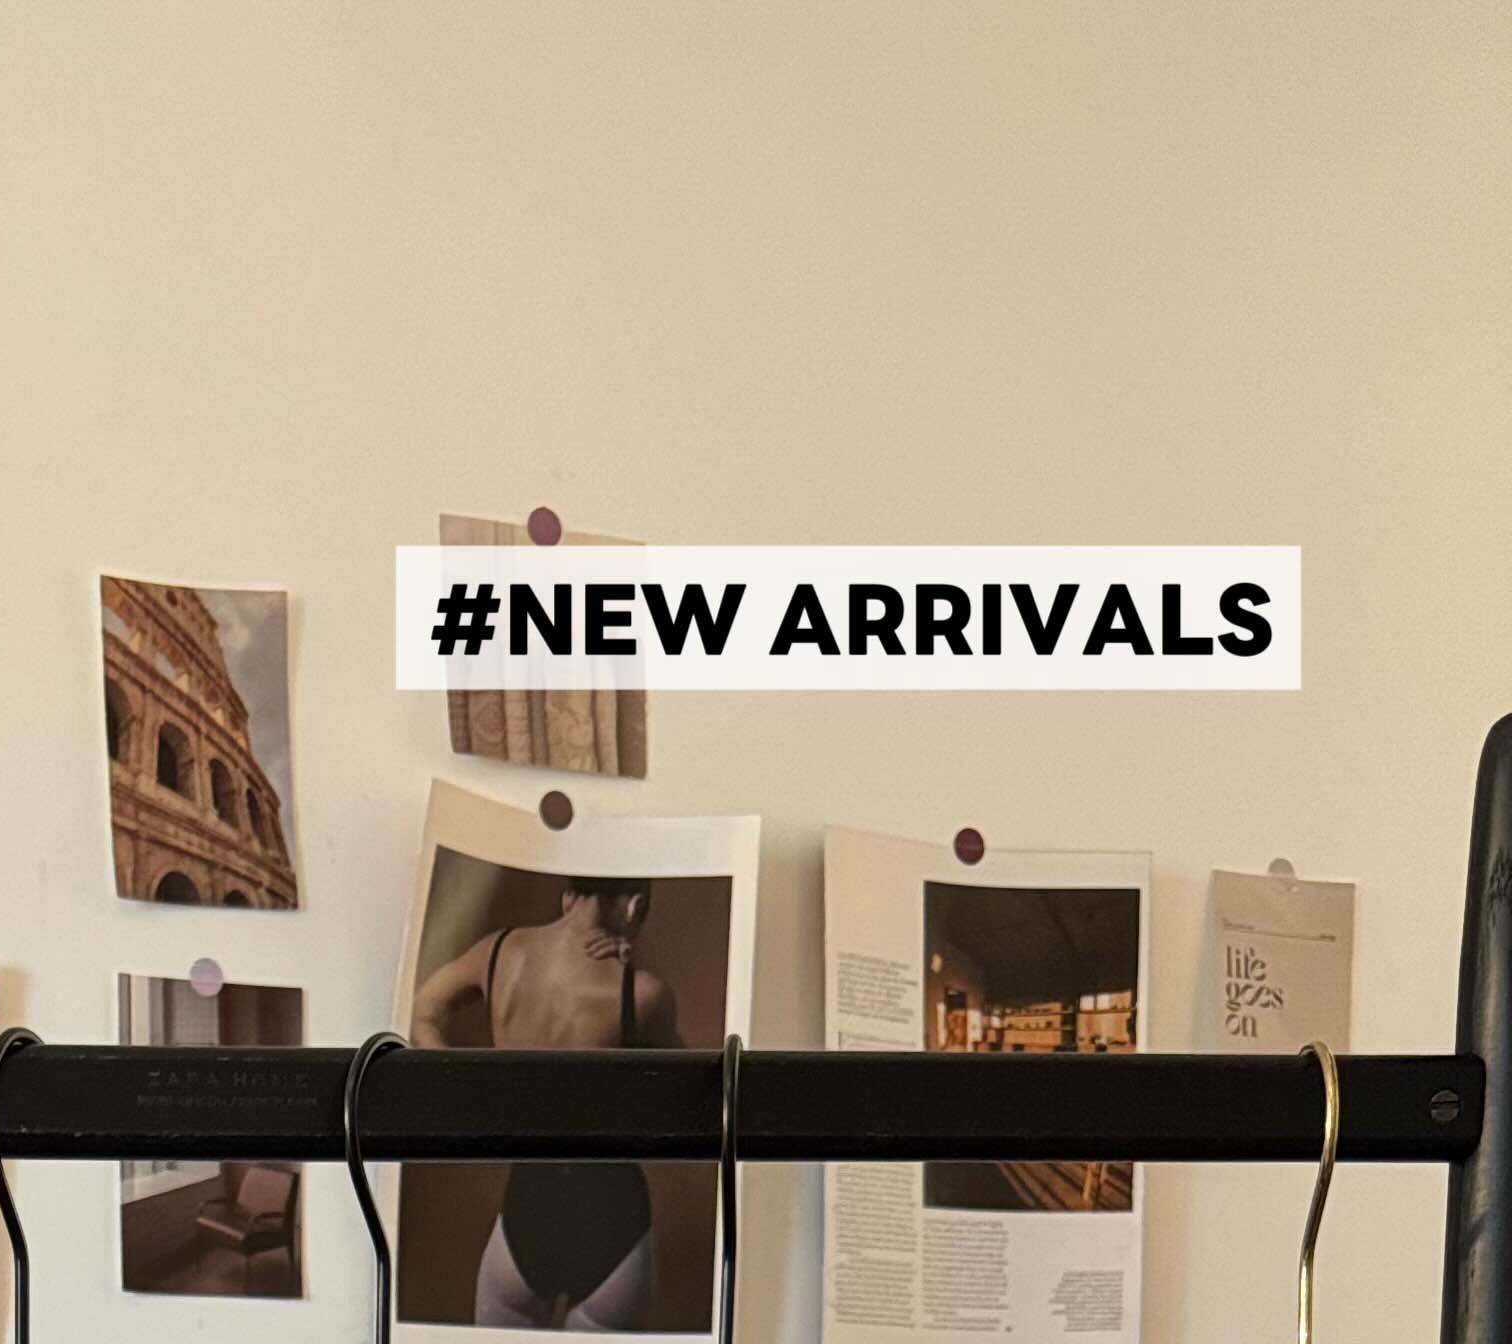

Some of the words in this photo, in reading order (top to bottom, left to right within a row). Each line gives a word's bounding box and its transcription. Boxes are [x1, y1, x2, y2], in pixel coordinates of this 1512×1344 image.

[1226, 945, 1267, 981] life
[1225, 982, 1285, 1012] goes
[1225, 1013, 1257, 1038] on
